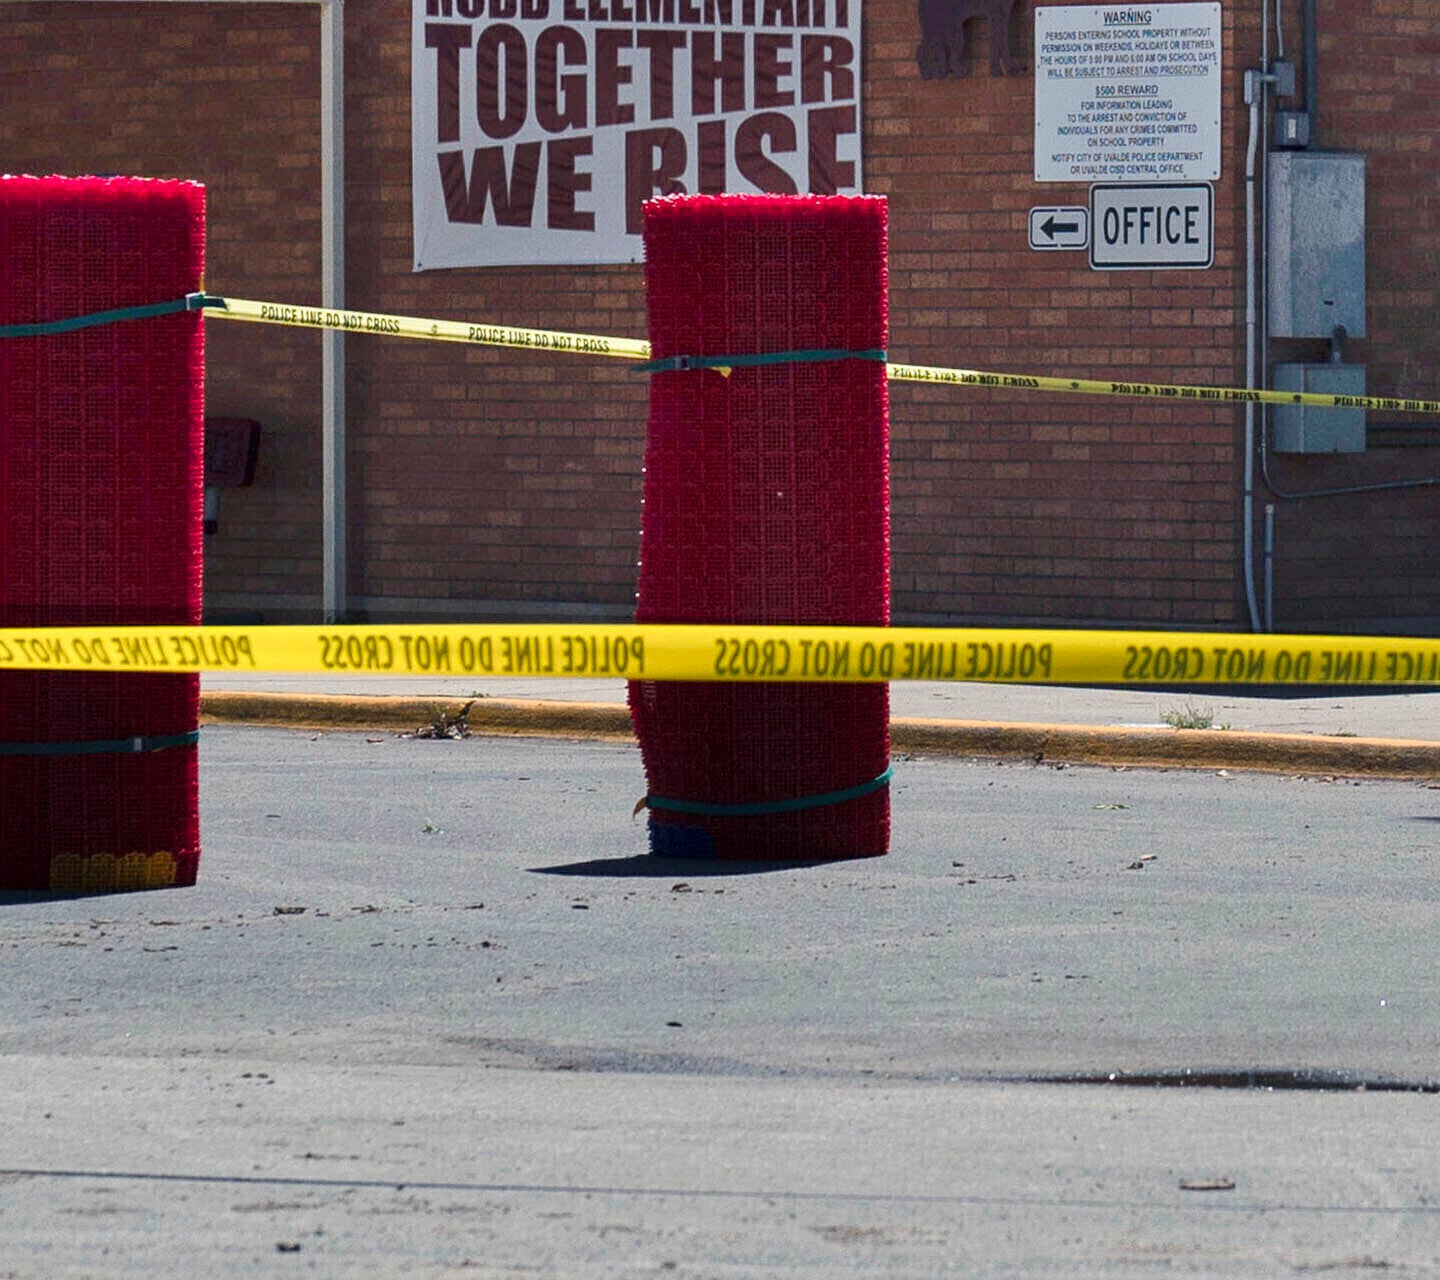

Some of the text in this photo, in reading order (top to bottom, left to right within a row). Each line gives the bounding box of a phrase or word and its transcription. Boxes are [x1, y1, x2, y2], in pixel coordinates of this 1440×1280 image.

[1103, 10, 1152, 23] WARNING
[1045, 28, 1211, 40] PERSONS ENTERING SCHOOL PROPERTY WITHOUT
[1041, 44, 1081, 53] PERMISSION
[1083, 43, 1093, 52] ON
[1135, 41, 1168, 50] HOLIDAYS
[1170, 41, 1180, 49] OR
[1182, 40, 1214, 49] BETWEEN
[424, 23, 855, 144] TOGETHER
[1096, 85, 1158, 96] $500 REWARD
[1081, 100, 1172, 110] FOR INFORMATION LEADING
[1068, 112, 1187, 122] TO THE ARREST AND CONVICTION OF
[1057, 125, 1197, 135] INDIVIDUALS FOR ANY CRIMES COMMITTED
[1088, 137, 1164, 147] ON SCHOOL PROPERTY
[1052, 152, 1203, 162] NOTIFY CITY OF UVALDE POLICE DEPARTMENT
[1071, 166, 1080, 174] OR
[1082, 166, 1108, 174] UVALDE
[1127, 165, 1157, 174] CENTRAL
[1159, 165, 1183, 173] OFFICE
[437, 135, 595, 232] WE
[1103, 206, 1199, 244] OFFICE
[261, 305, 400, 333] POLICE LINE DO NOT CROSS
[468, 327, 610, 353] POLICE LINE DO NOT CROSS
